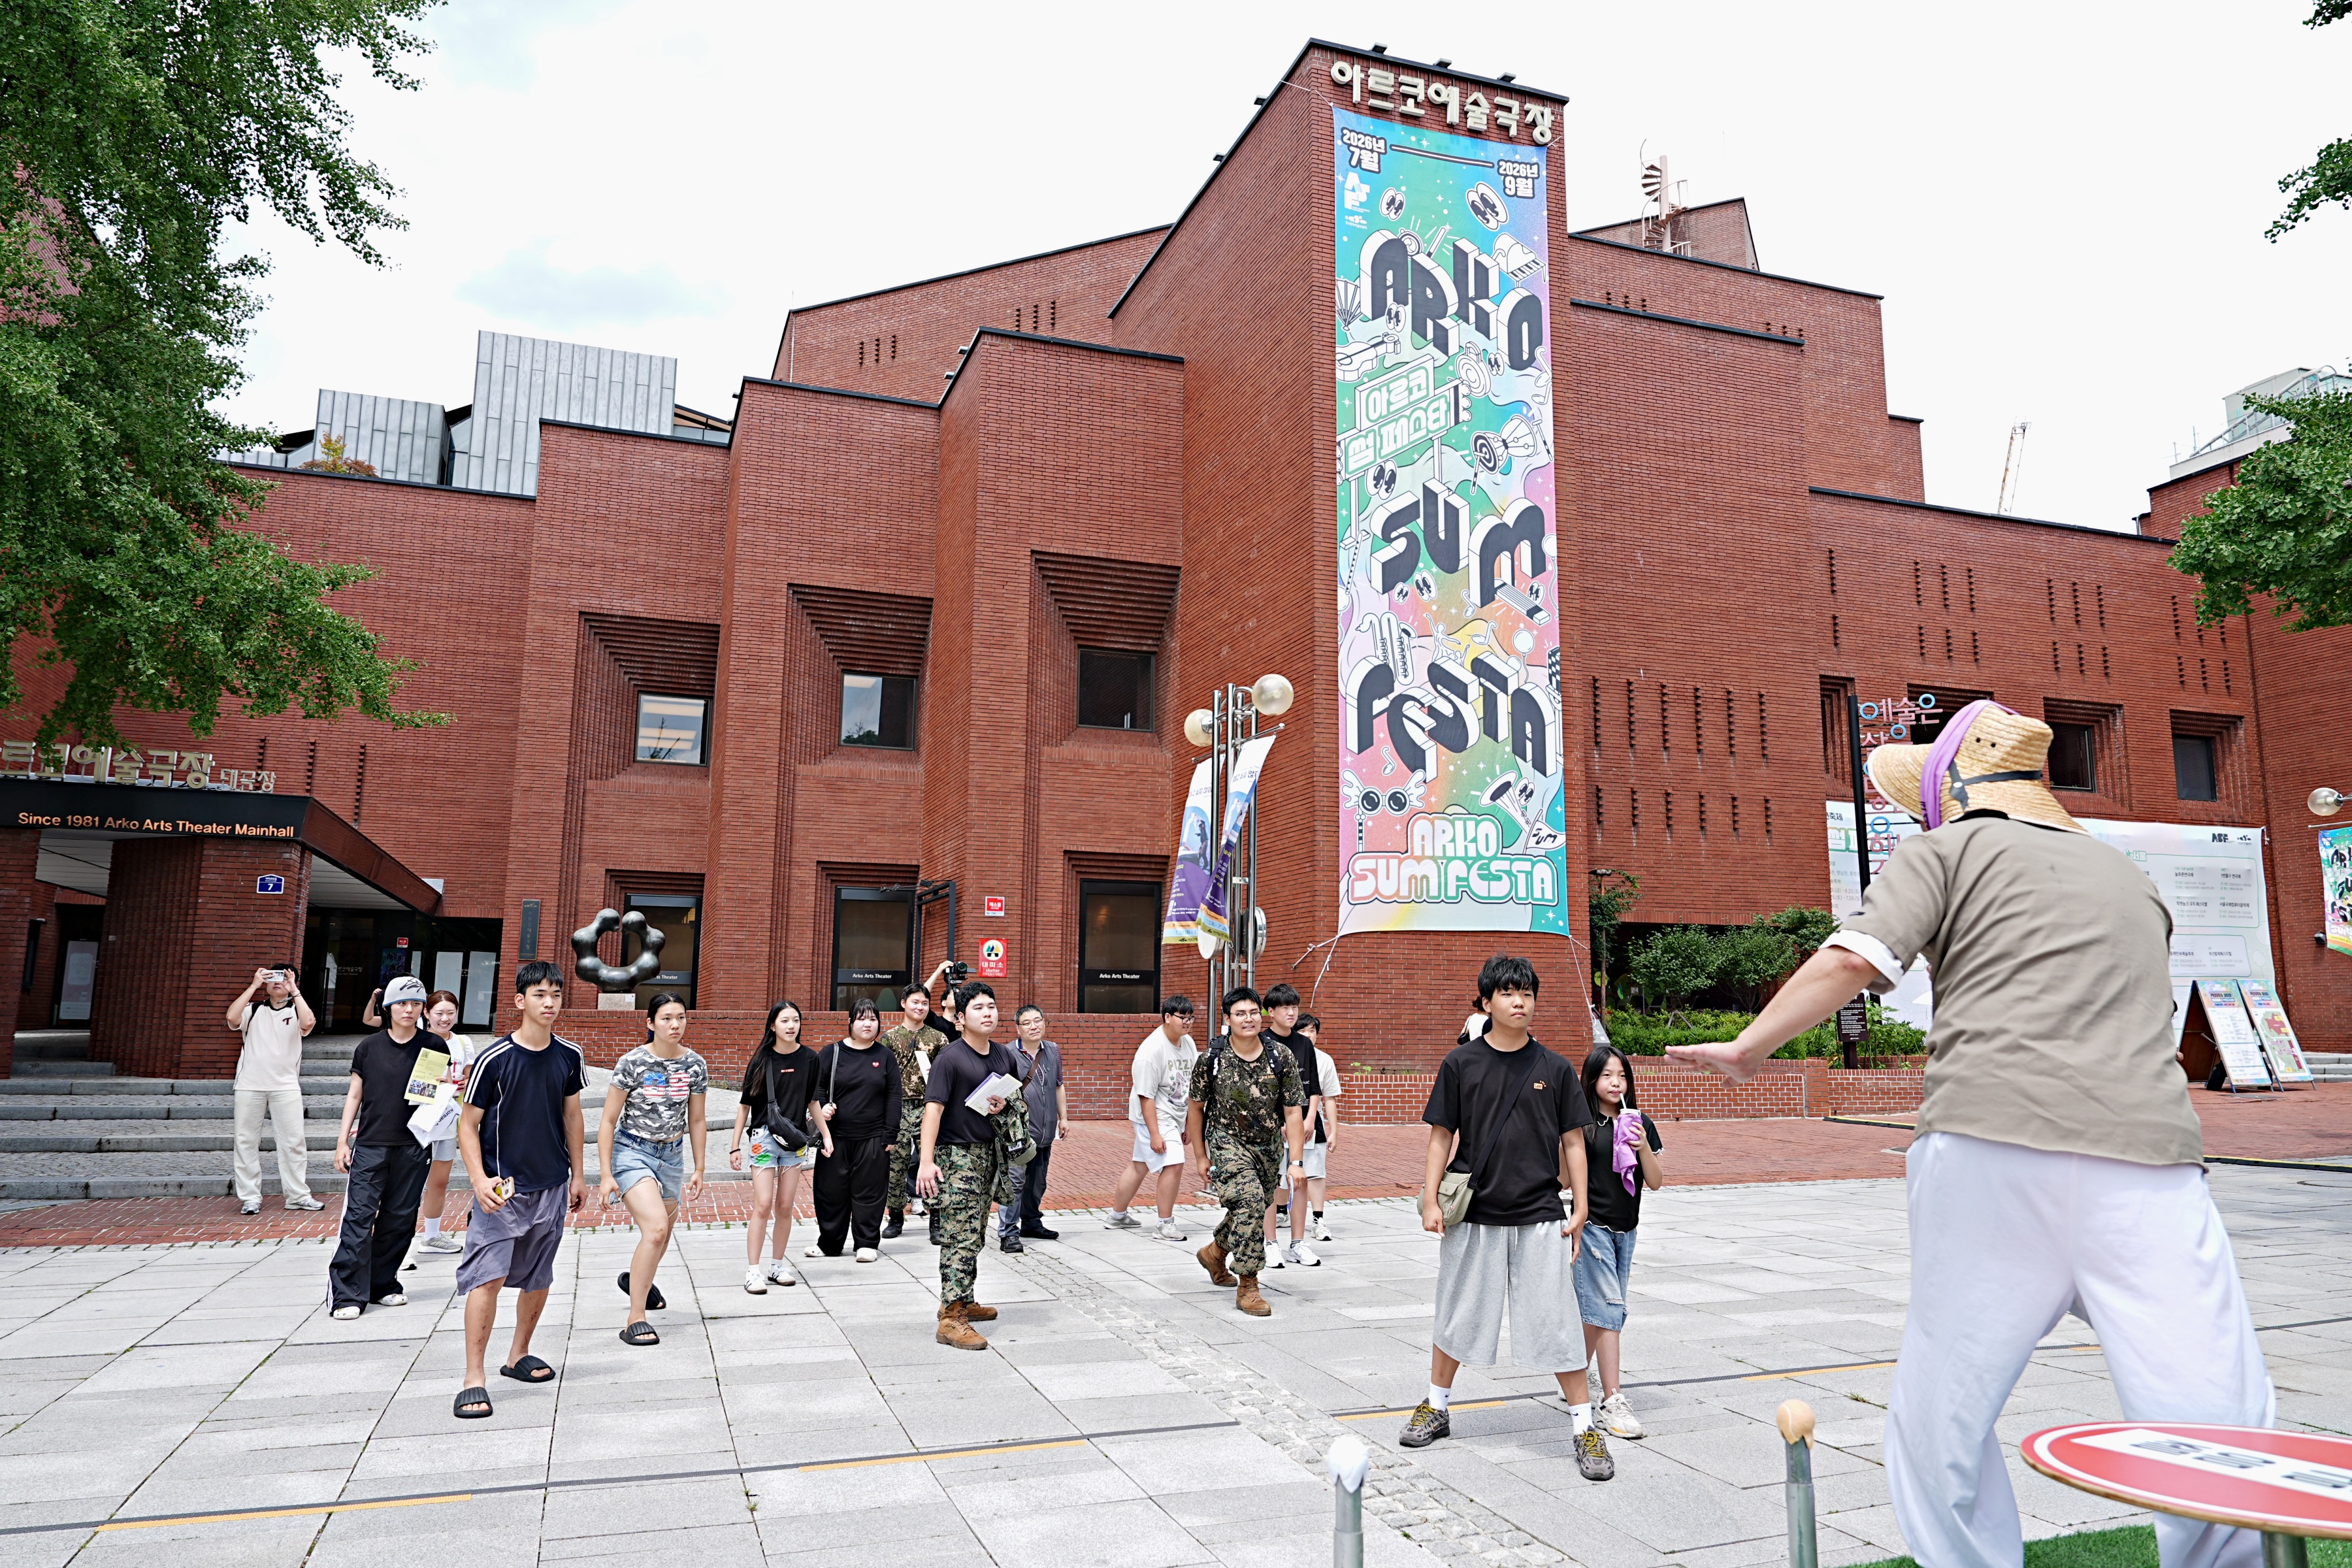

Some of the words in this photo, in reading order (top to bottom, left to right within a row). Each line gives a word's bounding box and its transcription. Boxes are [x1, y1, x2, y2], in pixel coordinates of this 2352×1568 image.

[1330, 61, 1555, 145] 아르코예술극장
[1343, 129, 1386, 153] 2026년
[1349, 146, 1379, 172] 7월
[1498, 161, 1539, 179] 2026년
[1505, 176, 1534, 198] 9월
[1360, 229, 1543, 371] ARKO
[1365, 367, 1429, 423] 아르코
[1348, 435, 1375, 472] 썸
[1379, 398, 1449, 456] 페스타
[1369, 478, 1547, 609] SUM
[1345, 651, 1557, 784] FESTA
[1859, 693, 1944, 725] 예술은
[0, 740, 215, 790] 르코예술극장
[18, 812, 61, 826] Since
[67, 815, 99, 827] 1981
[105, 817, 139, 830] Arko
[143, 819, 172, 832] Arts
[176, 821, 231, 835] Theater
[235, 823, 294, 838] Mainhall
[1413, 820, 1498, 858] ARKO
[1533, 828, 1558, 845] SUM
[2212, 833, 2229, 843] ASF
[2132, 851, 2147, 862] 서울
